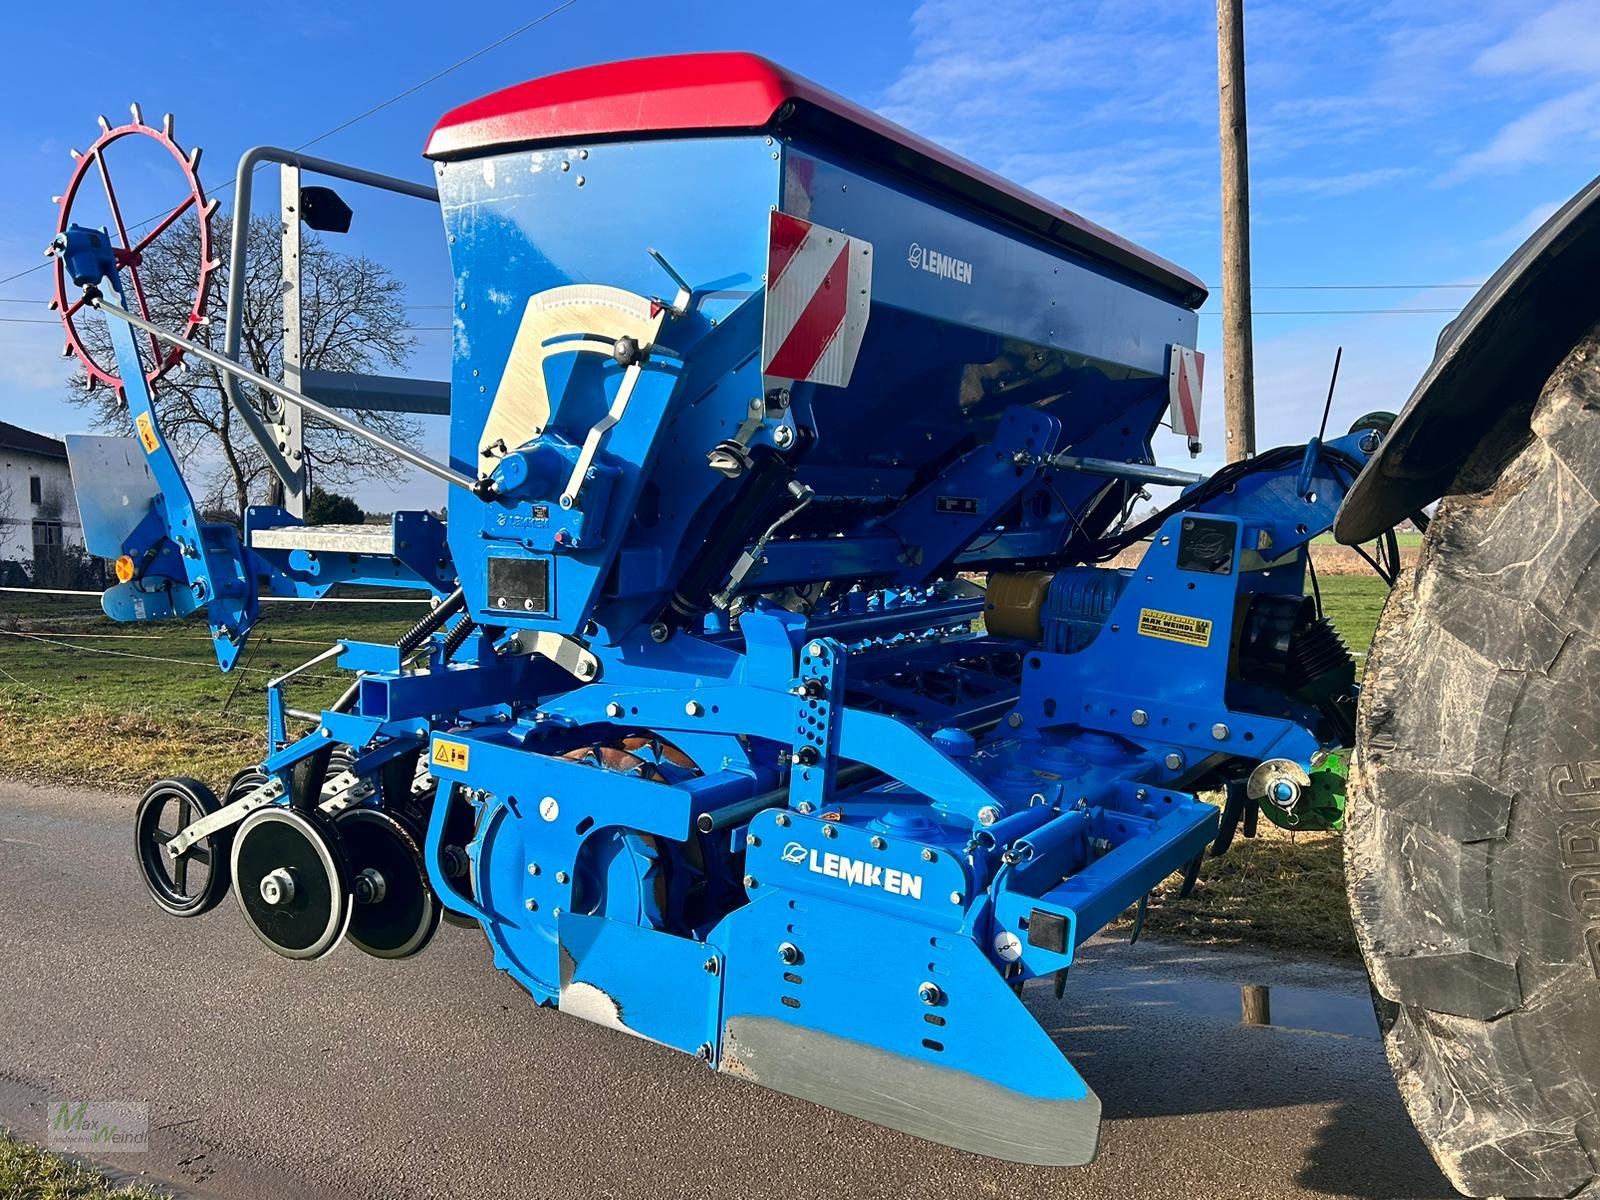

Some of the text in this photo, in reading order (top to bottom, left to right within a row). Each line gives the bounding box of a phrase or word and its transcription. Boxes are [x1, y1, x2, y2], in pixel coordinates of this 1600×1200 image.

[922, 248, 972, 284] LEMKEN
[1142, 617, 1194, 632] MAX WEINDL
[809, 848, 922, 900] LEMKEN
